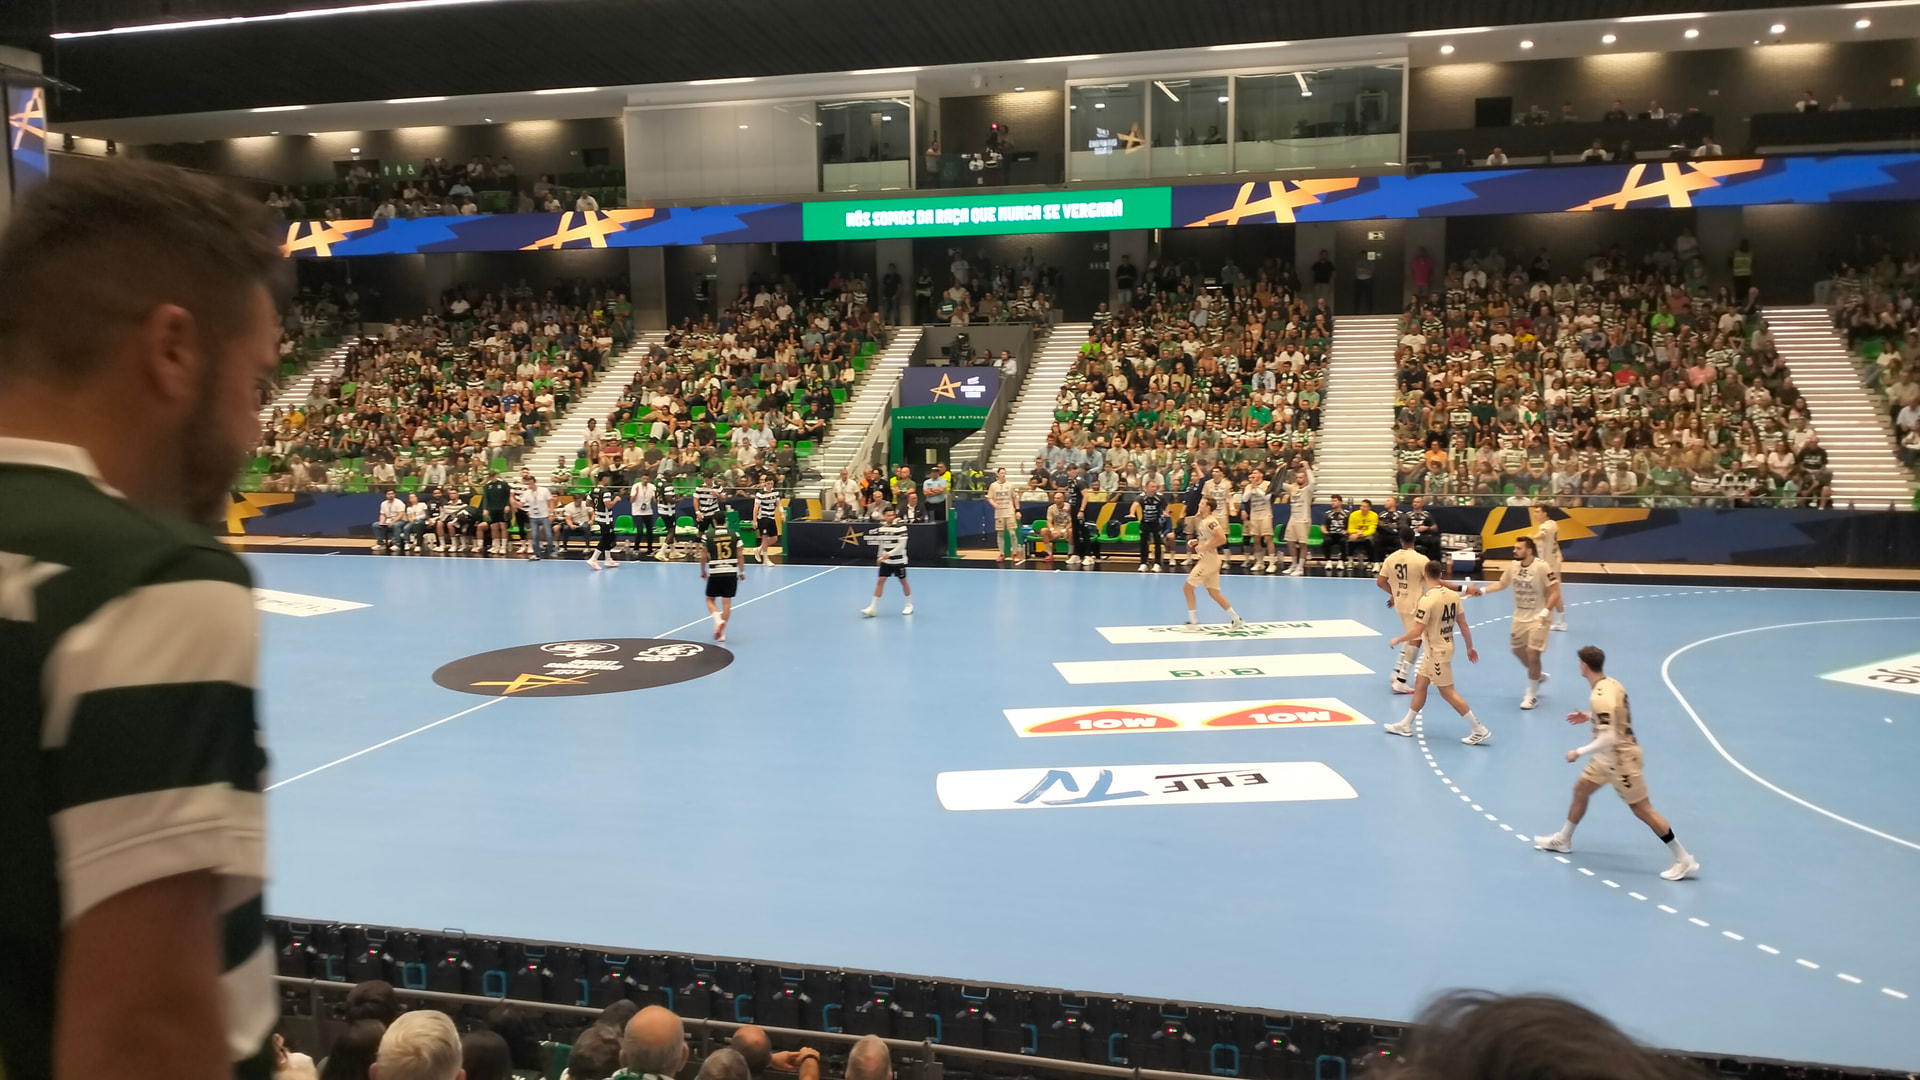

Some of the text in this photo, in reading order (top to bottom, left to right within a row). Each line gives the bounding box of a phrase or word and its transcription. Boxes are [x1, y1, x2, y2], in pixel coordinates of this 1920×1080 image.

[845, 199, 1123, 227] NÓS SOMOS DA RAÇA QUE NUNCA SE VERGARÁ
[1395, 564, 1408, 580] 31
[1441, 603, 1456, 623] 44
[1074, 717, 1157, 730] MOL
[1249, 711, 1331, 723] MOL
[1014, 769, 1270, 805] EHF TV
